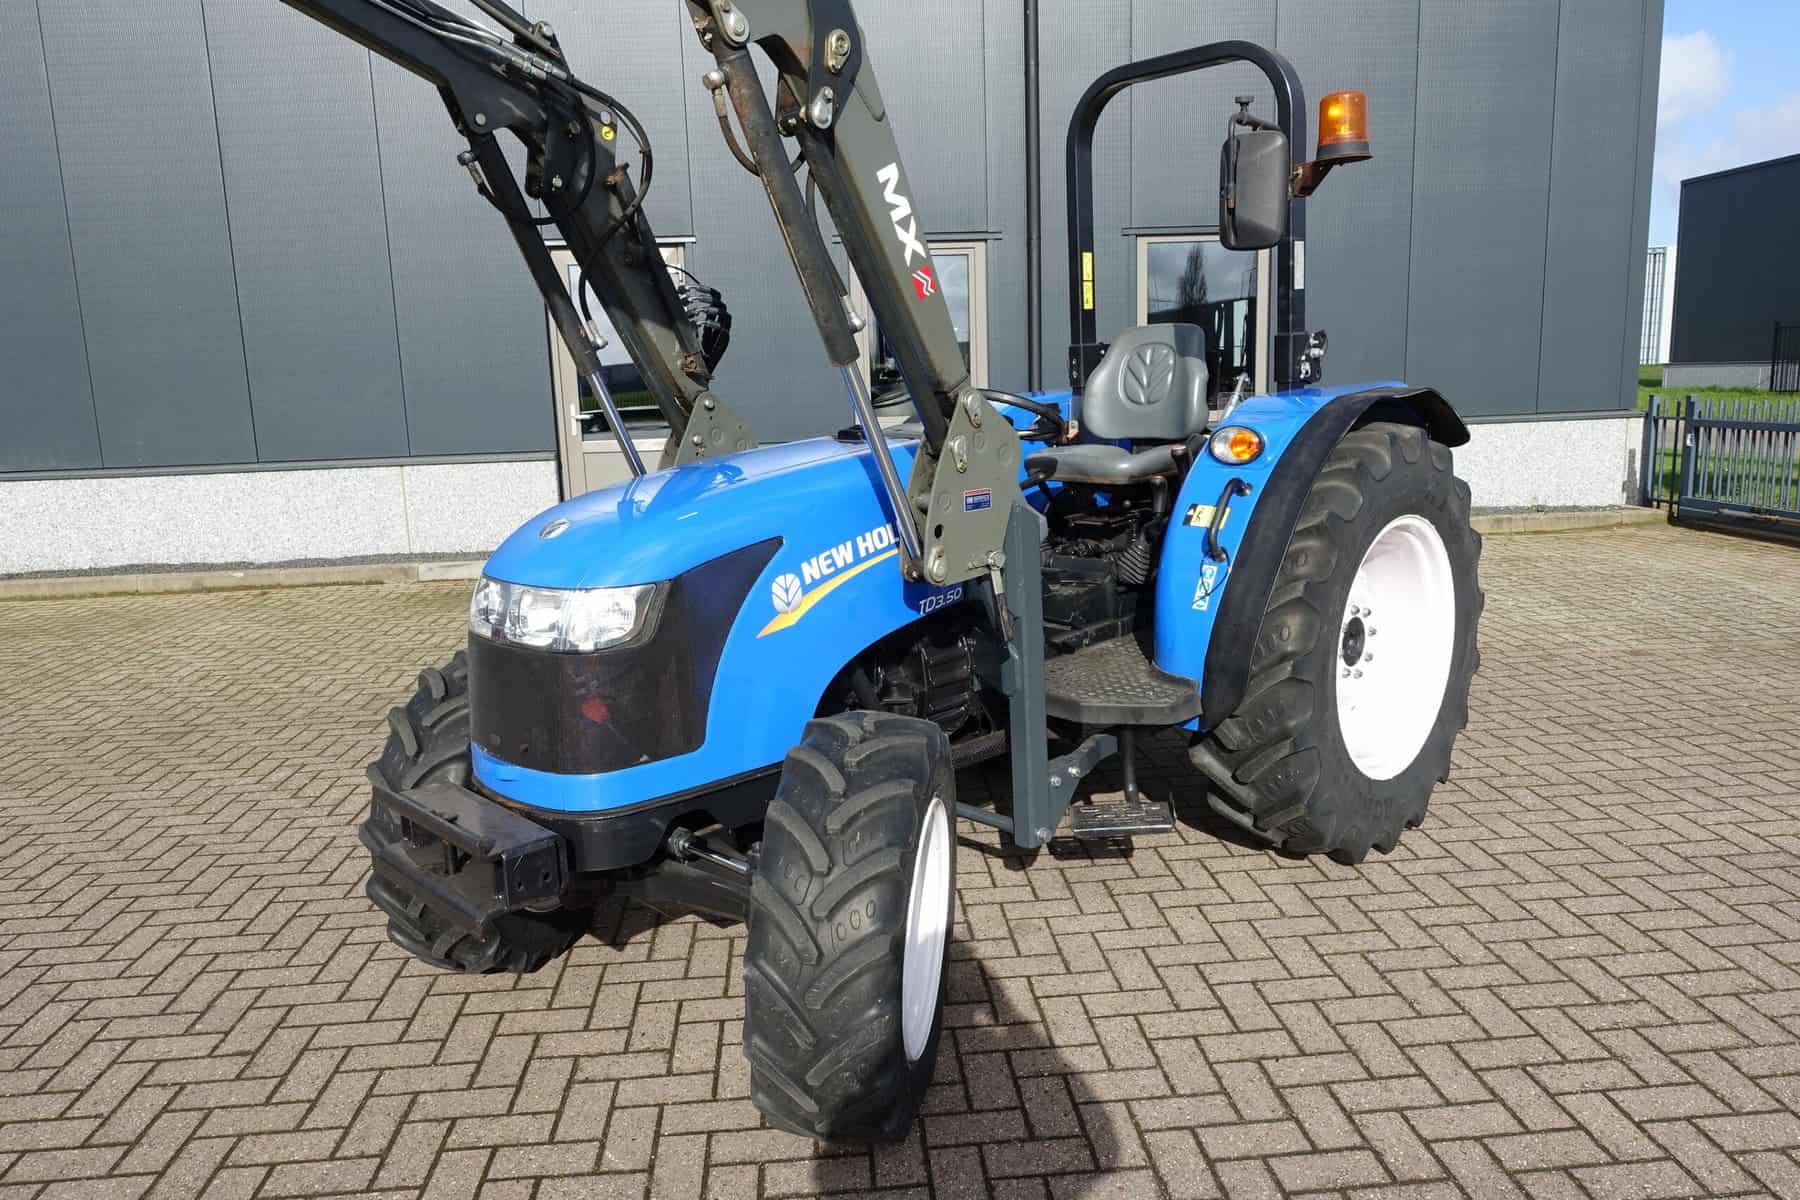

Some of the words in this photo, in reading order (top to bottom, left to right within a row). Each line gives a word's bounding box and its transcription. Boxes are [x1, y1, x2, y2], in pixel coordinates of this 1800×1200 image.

[876, 162, 927, 267] MX
[801, 540, 854, 585] NEW
[919, 587, 962, 617] TD3.50
